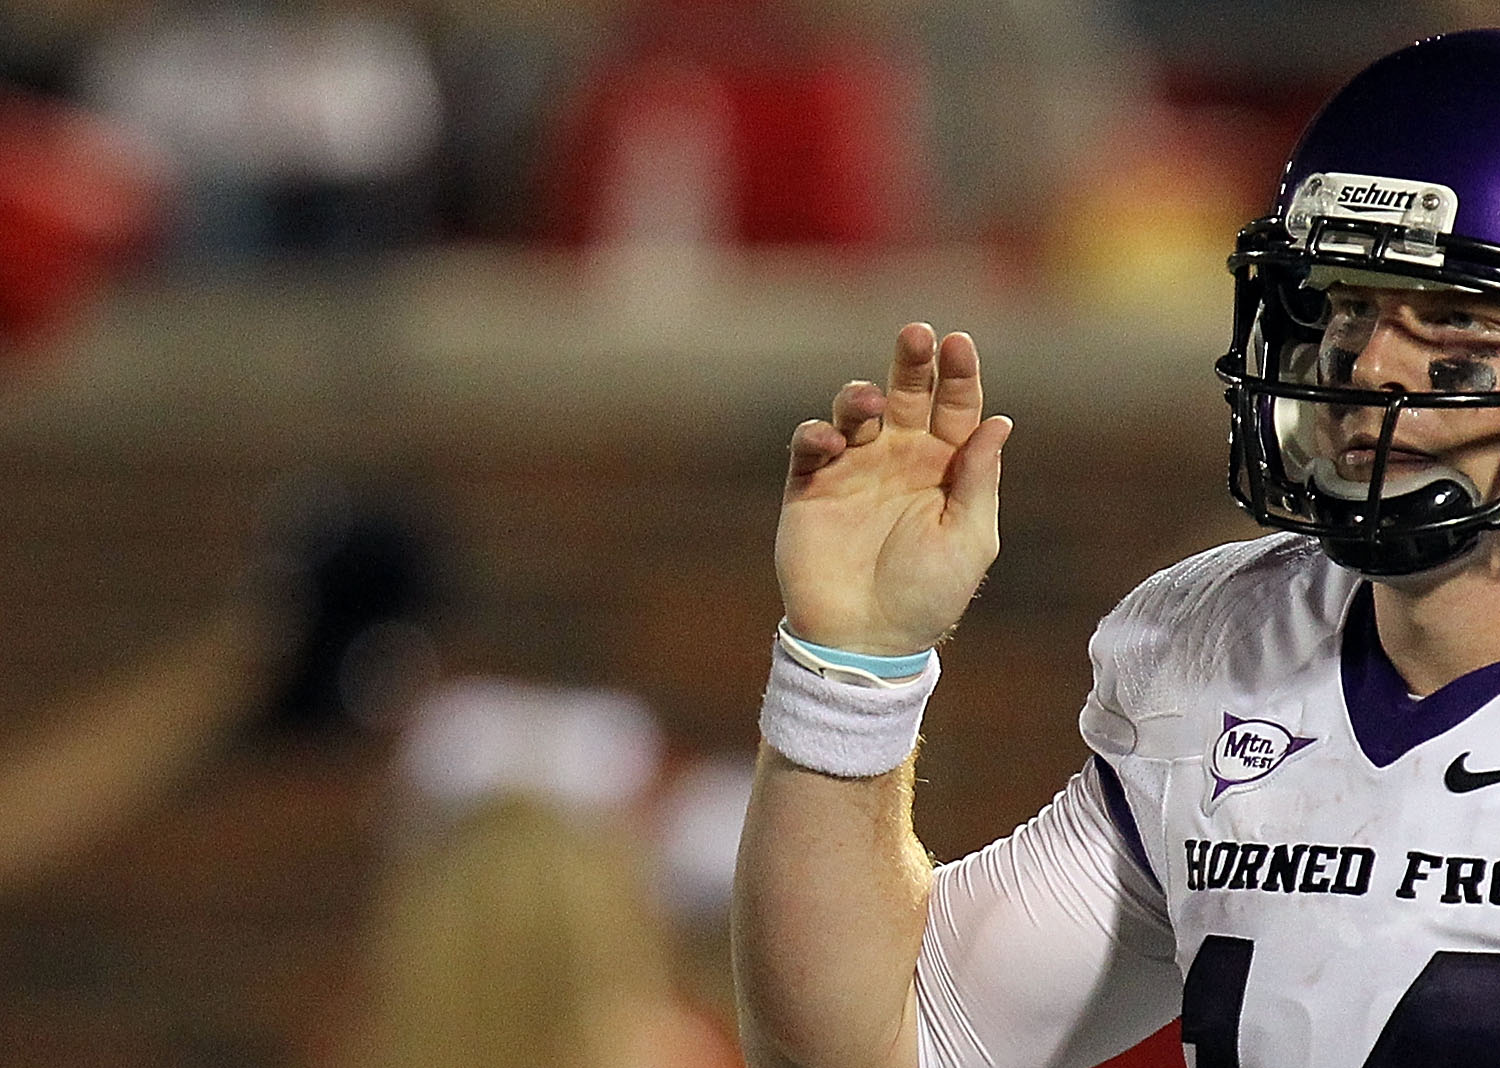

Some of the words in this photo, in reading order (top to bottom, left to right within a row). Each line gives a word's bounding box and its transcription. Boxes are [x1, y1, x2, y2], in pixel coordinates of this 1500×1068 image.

[1337, 183, 1417, 210] schutt
[1223, 731, 1274, 759] Mtn.
[1242, 756, 1274, 769] WEST
[1184, 840, 1376, 896] HORNED
